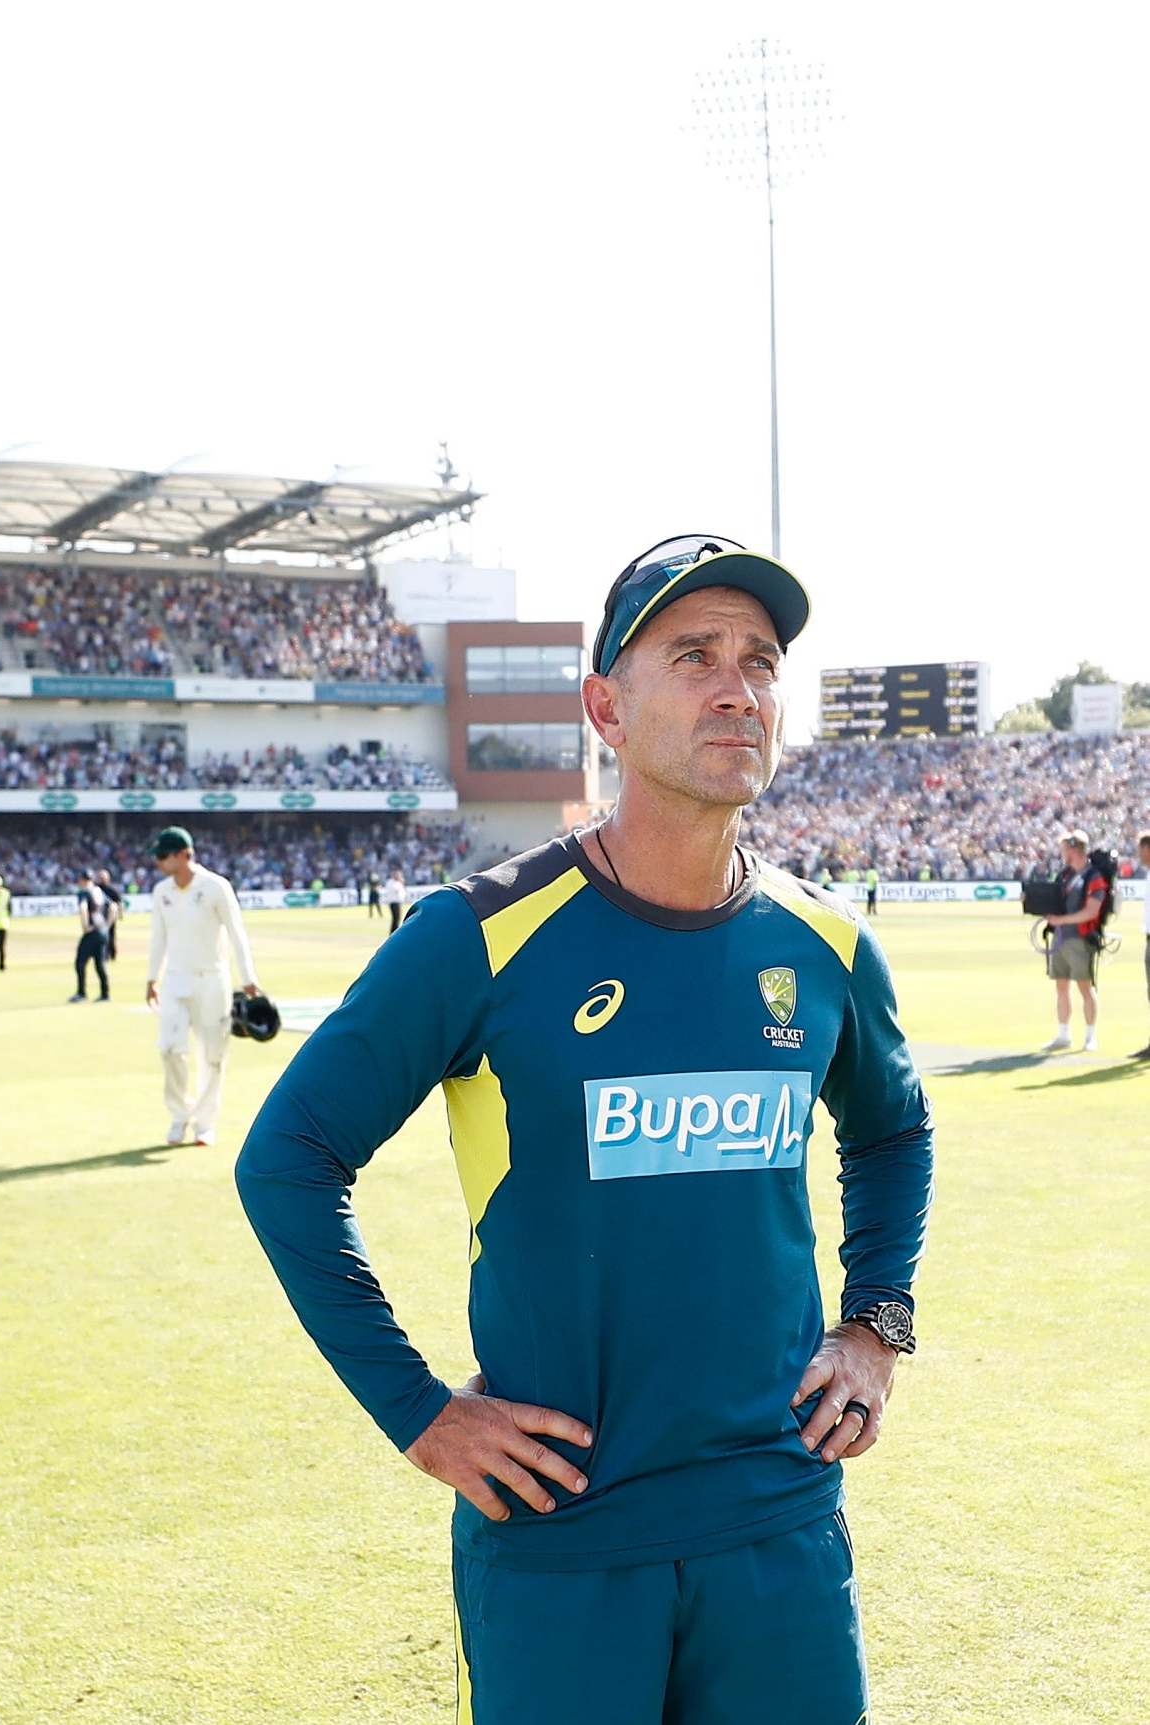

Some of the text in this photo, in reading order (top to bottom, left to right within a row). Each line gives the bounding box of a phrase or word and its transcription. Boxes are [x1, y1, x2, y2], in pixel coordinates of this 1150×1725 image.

[908, 885, 956, 900] Experts
[763, 1026, 805, 1043] CRICKET
[771, 1040, 801, 1050] AUSTRALIA
[594, 1086, 762, 1153] Bupa
